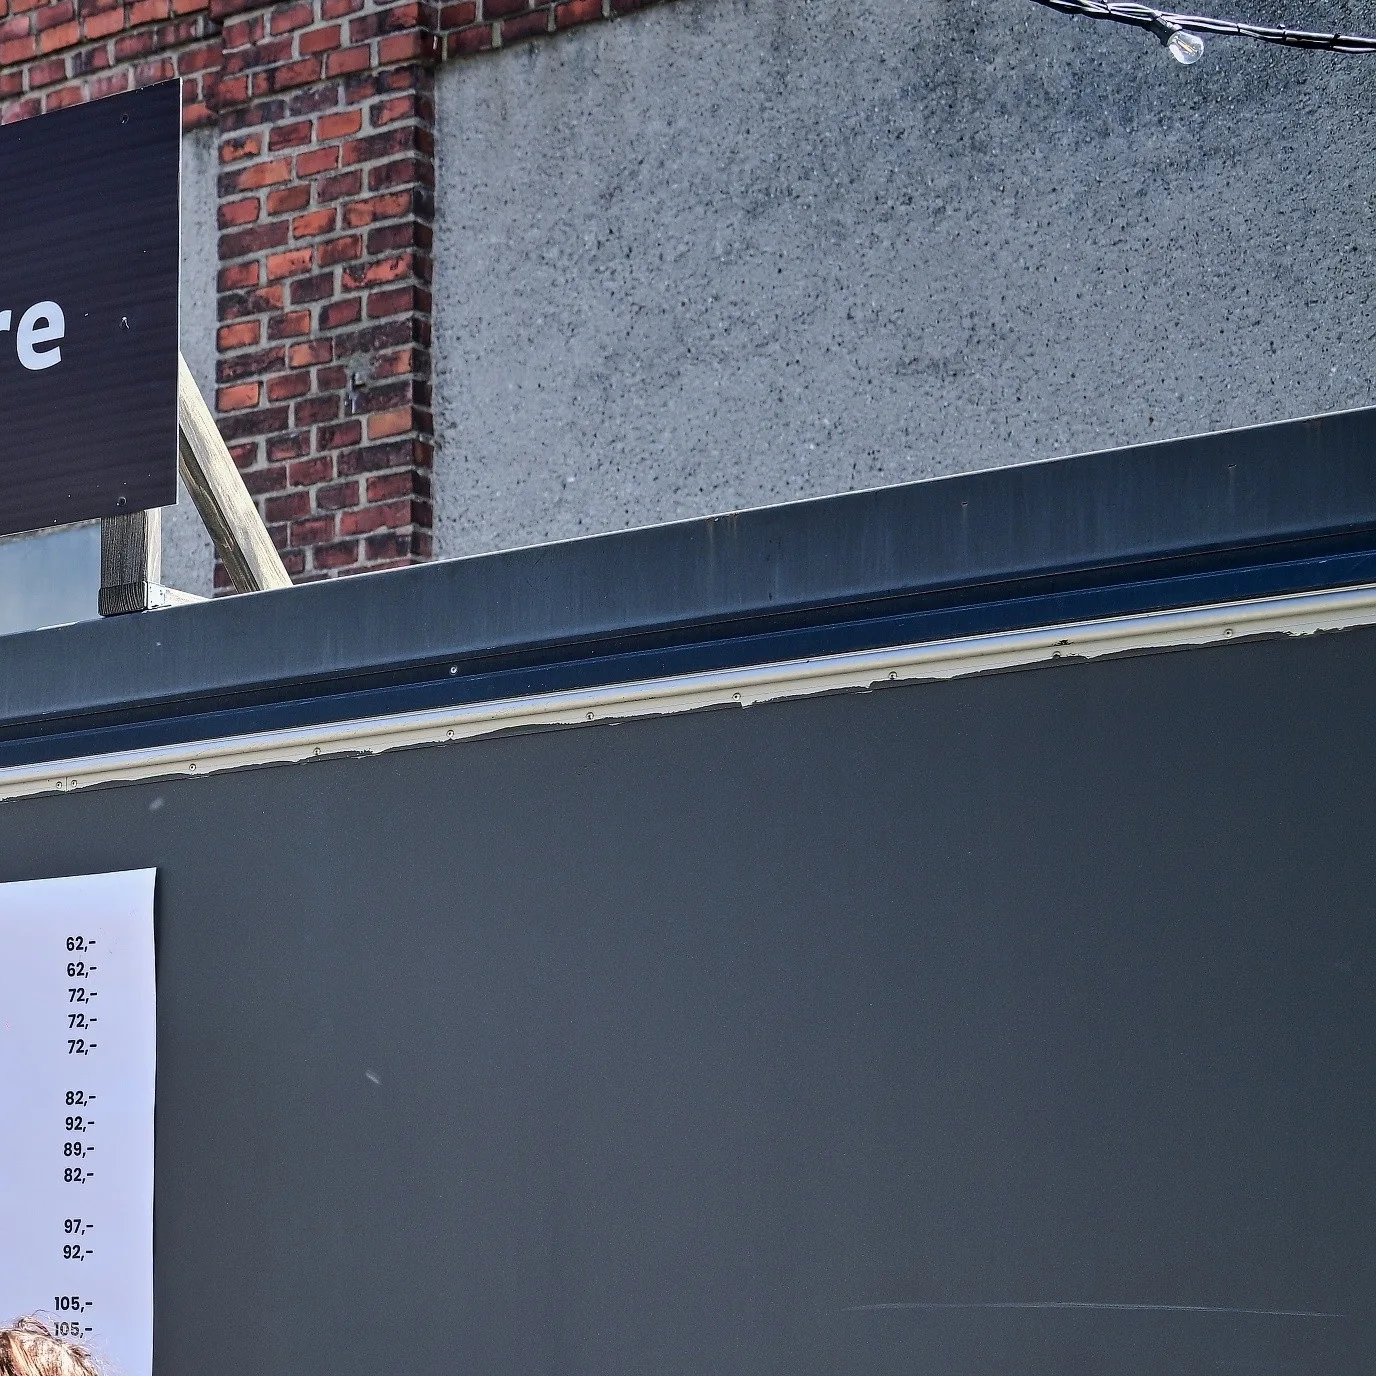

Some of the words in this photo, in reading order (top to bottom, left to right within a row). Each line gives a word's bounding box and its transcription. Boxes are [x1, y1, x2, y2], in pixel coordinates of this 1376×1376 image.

[66, 936, 96, 952] 62,-
[67, 962, 97, 978] 62,-
[68, 988, 97, 1004] 72,-
[68, 1013, 97, 1030] 72,-
[68, 1039, 97, 1055] 72,-
[65, 1090, 96, 1107] 82,-
[65, 1116, 95, 1132] 92,-
[64, 1142, 94, 1158] 89,-
[64, 1168, 94, 1184] 82,-
[64, 1219, 94, 1235] 97,-
[63, 1245, 93, 1261] 92,-
[54, 1296, 93, 1313] 105,-
[53, 1322, 93, 1338] 105,-
